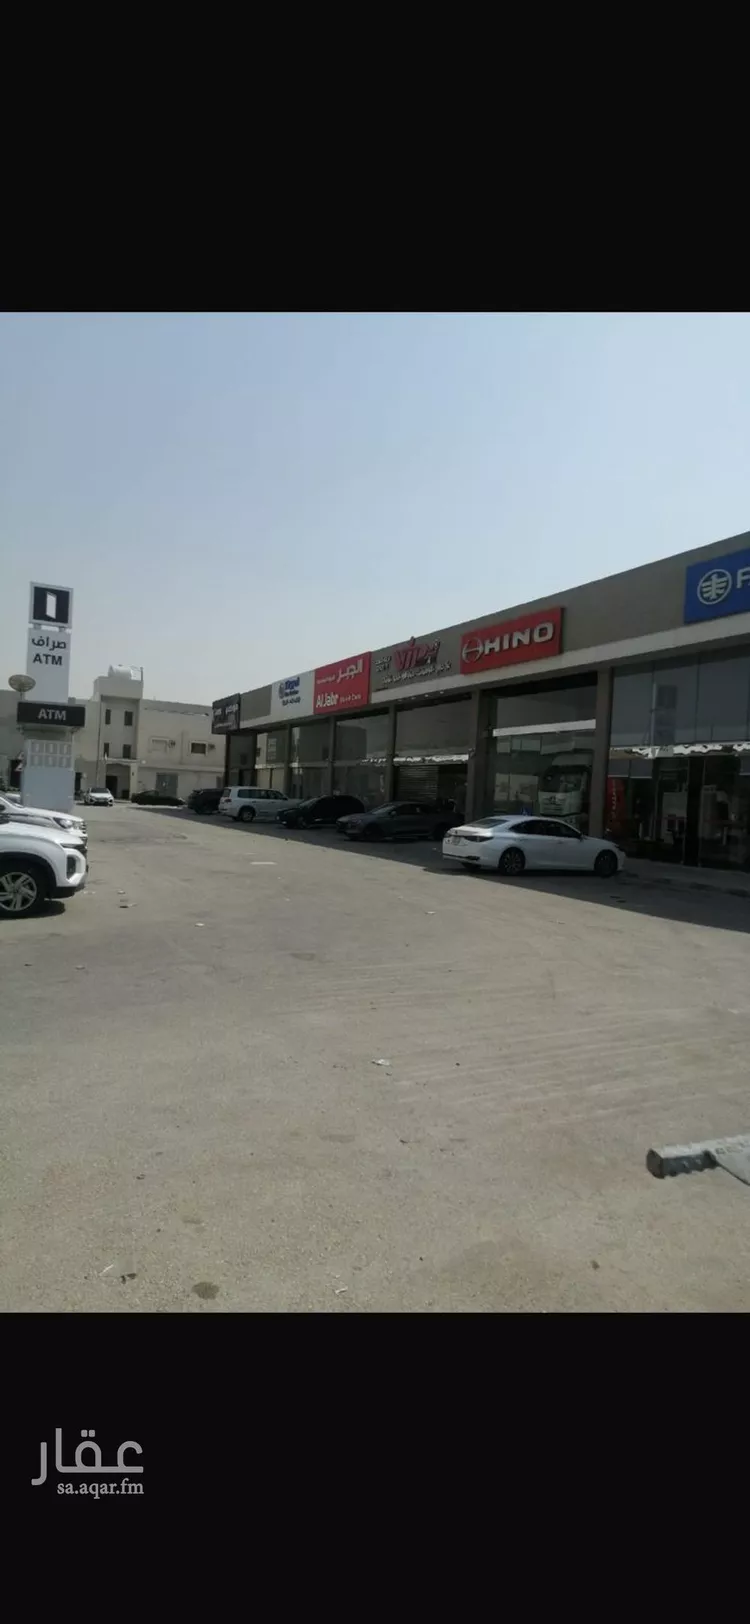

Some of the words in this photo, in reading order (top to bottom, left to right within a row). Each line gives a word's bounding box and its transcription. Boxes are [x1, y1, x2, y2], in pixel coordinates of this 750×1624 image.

[31, 635, 67, 651] صراف
[484, 622, 554, 655] HINO
[32, 653, 63, 666] ATM
[337, 659, 363, 683] الجبر
[37, 708, 67, 721] ATM
